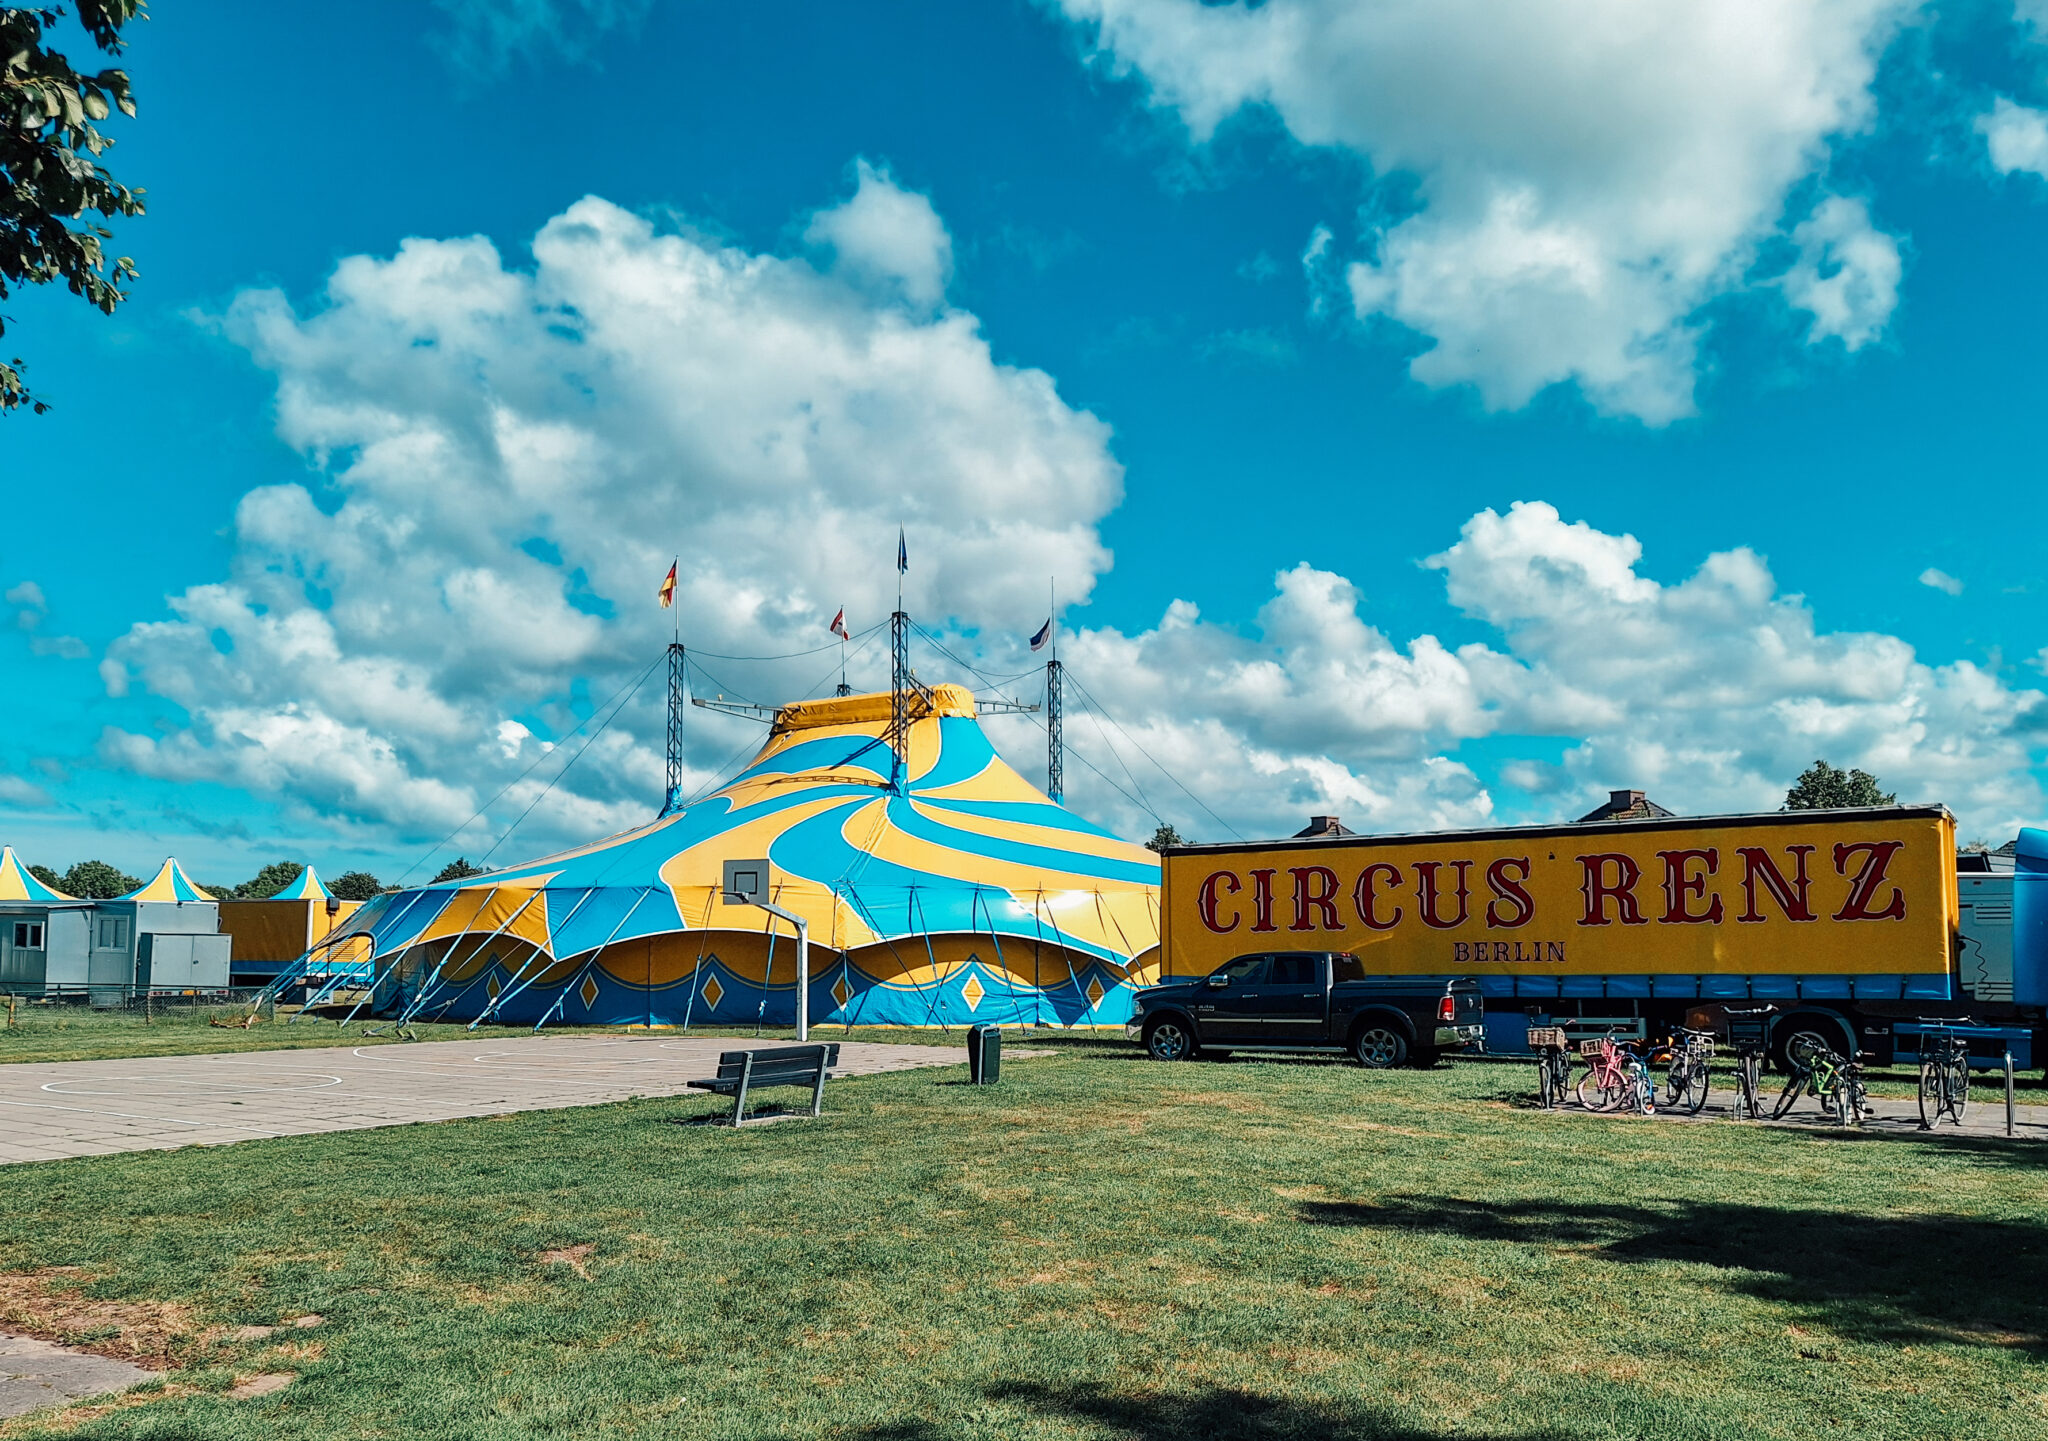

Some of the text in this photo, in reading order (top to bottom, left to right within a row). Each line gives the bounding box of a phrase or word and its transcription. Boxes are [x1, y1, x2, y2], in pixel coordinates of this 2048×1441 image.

[1197, 841, 1907, 935] CIRCUS RENZ
[1453, 941, 1566, 962] BERLIN
